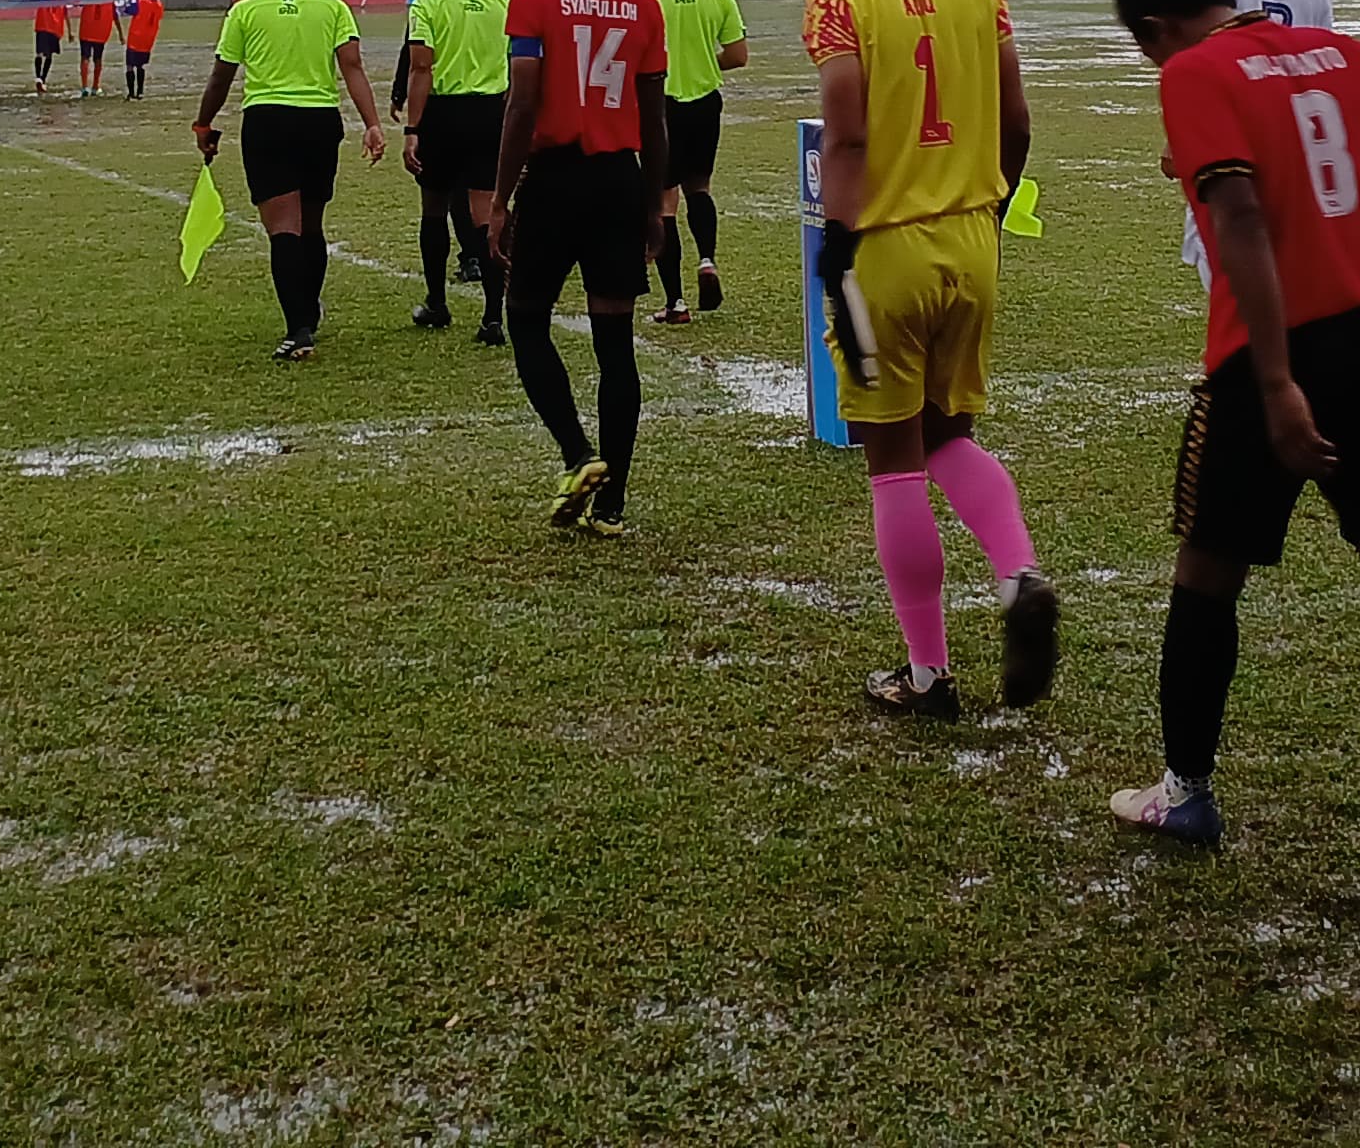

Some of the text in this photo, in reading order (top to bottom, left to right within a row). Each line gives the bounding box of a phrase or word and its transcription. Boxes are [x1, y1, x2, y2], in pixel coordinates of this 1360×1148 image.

[572, 24, 628, 109] 14
[914, 34, 953, 148] 1
[1290, 89, 1359, 218] 8
